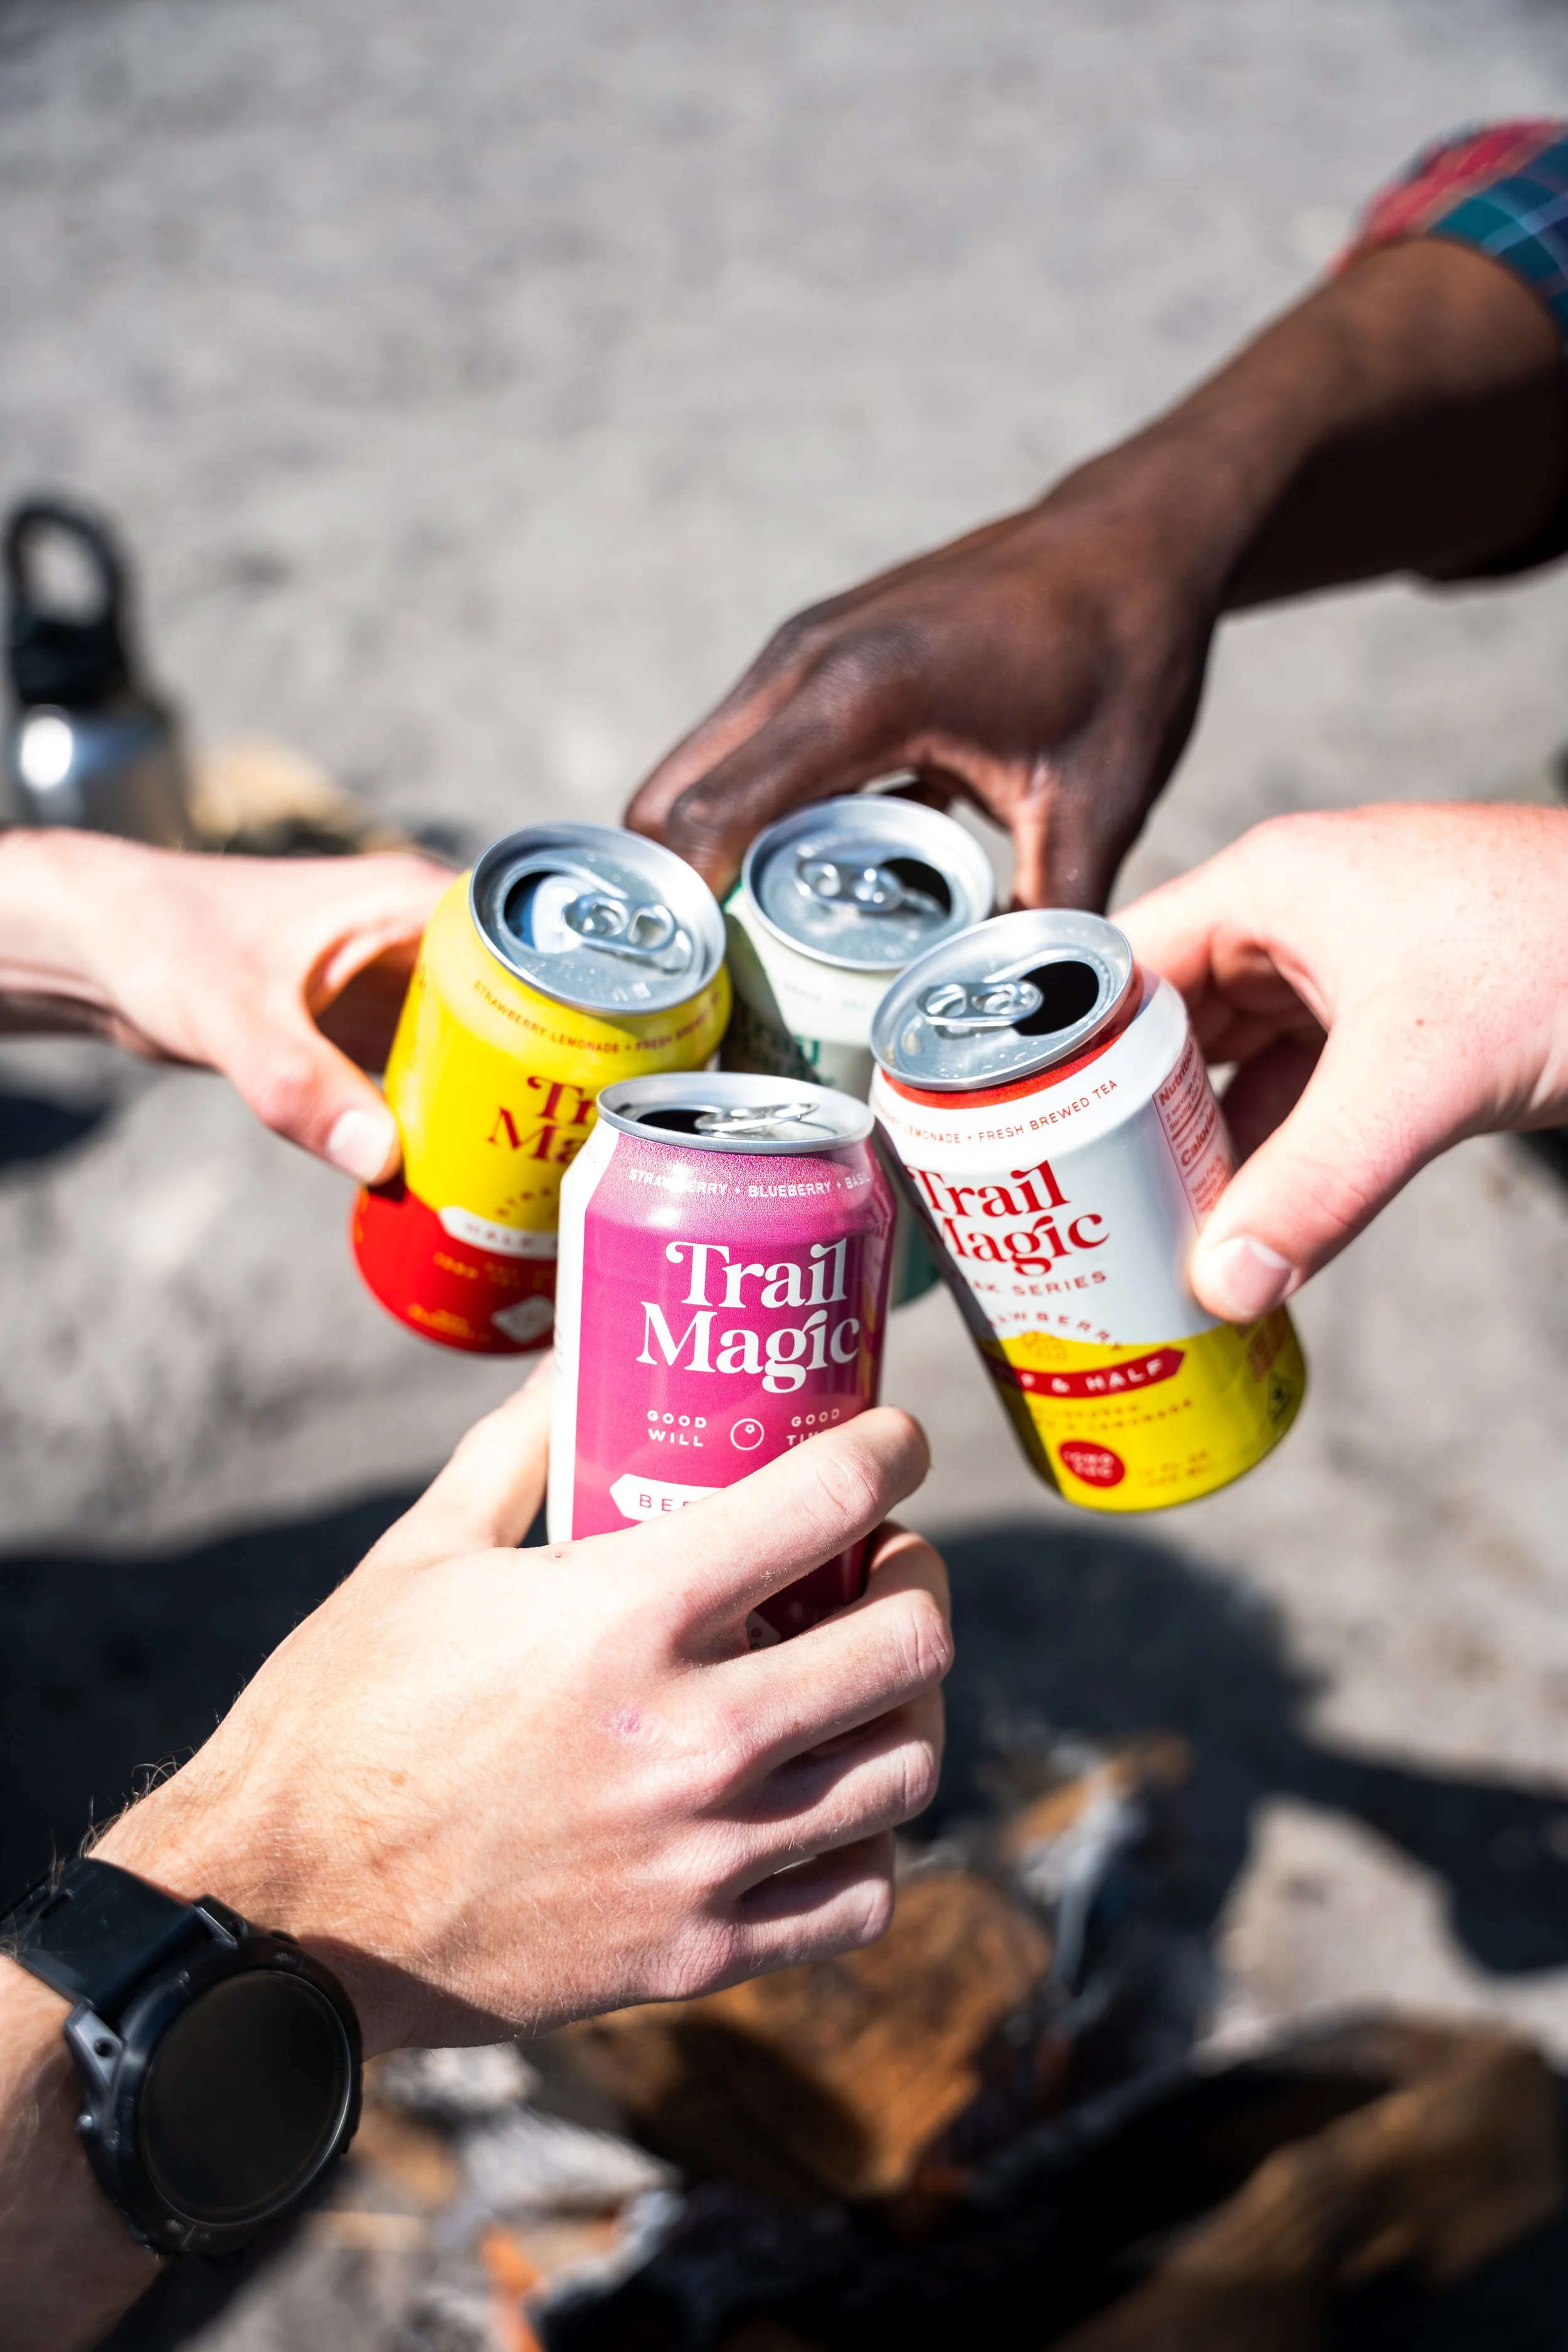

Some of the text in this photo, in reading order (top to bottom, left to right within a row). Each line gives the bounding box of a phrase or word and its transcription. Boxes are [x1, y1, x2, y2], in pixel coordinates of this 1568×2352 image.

[474, 980, 548, 1037] STRAWBERRY
[550, 1031, 619, 1054] LEMONADE
[978, 1124, 1024, 1142] FRESH
[1029, 1096, 1090, 1131] BREWED
[1092, 1079, 1118, 1099] TEA
[628, 1168, 871, 1197] STRAERRY BLUEBERRY BASL
[903, 1160, 1071, 1218] Trail
[914, 1204, 1110, 1277] Magic
[665, 1237, 847, 1309] Trail
[1012, 1270, 1108, 1296] SERIES
[636, 1301, 860, 1394] Magic
[1086, 1357, 1164, 1391] HALF
[647, 1409, 707, 1428] GOOD
[648, 1428, 704, 1447] WILL
[791, 1408, 840, 1428] GOOD
